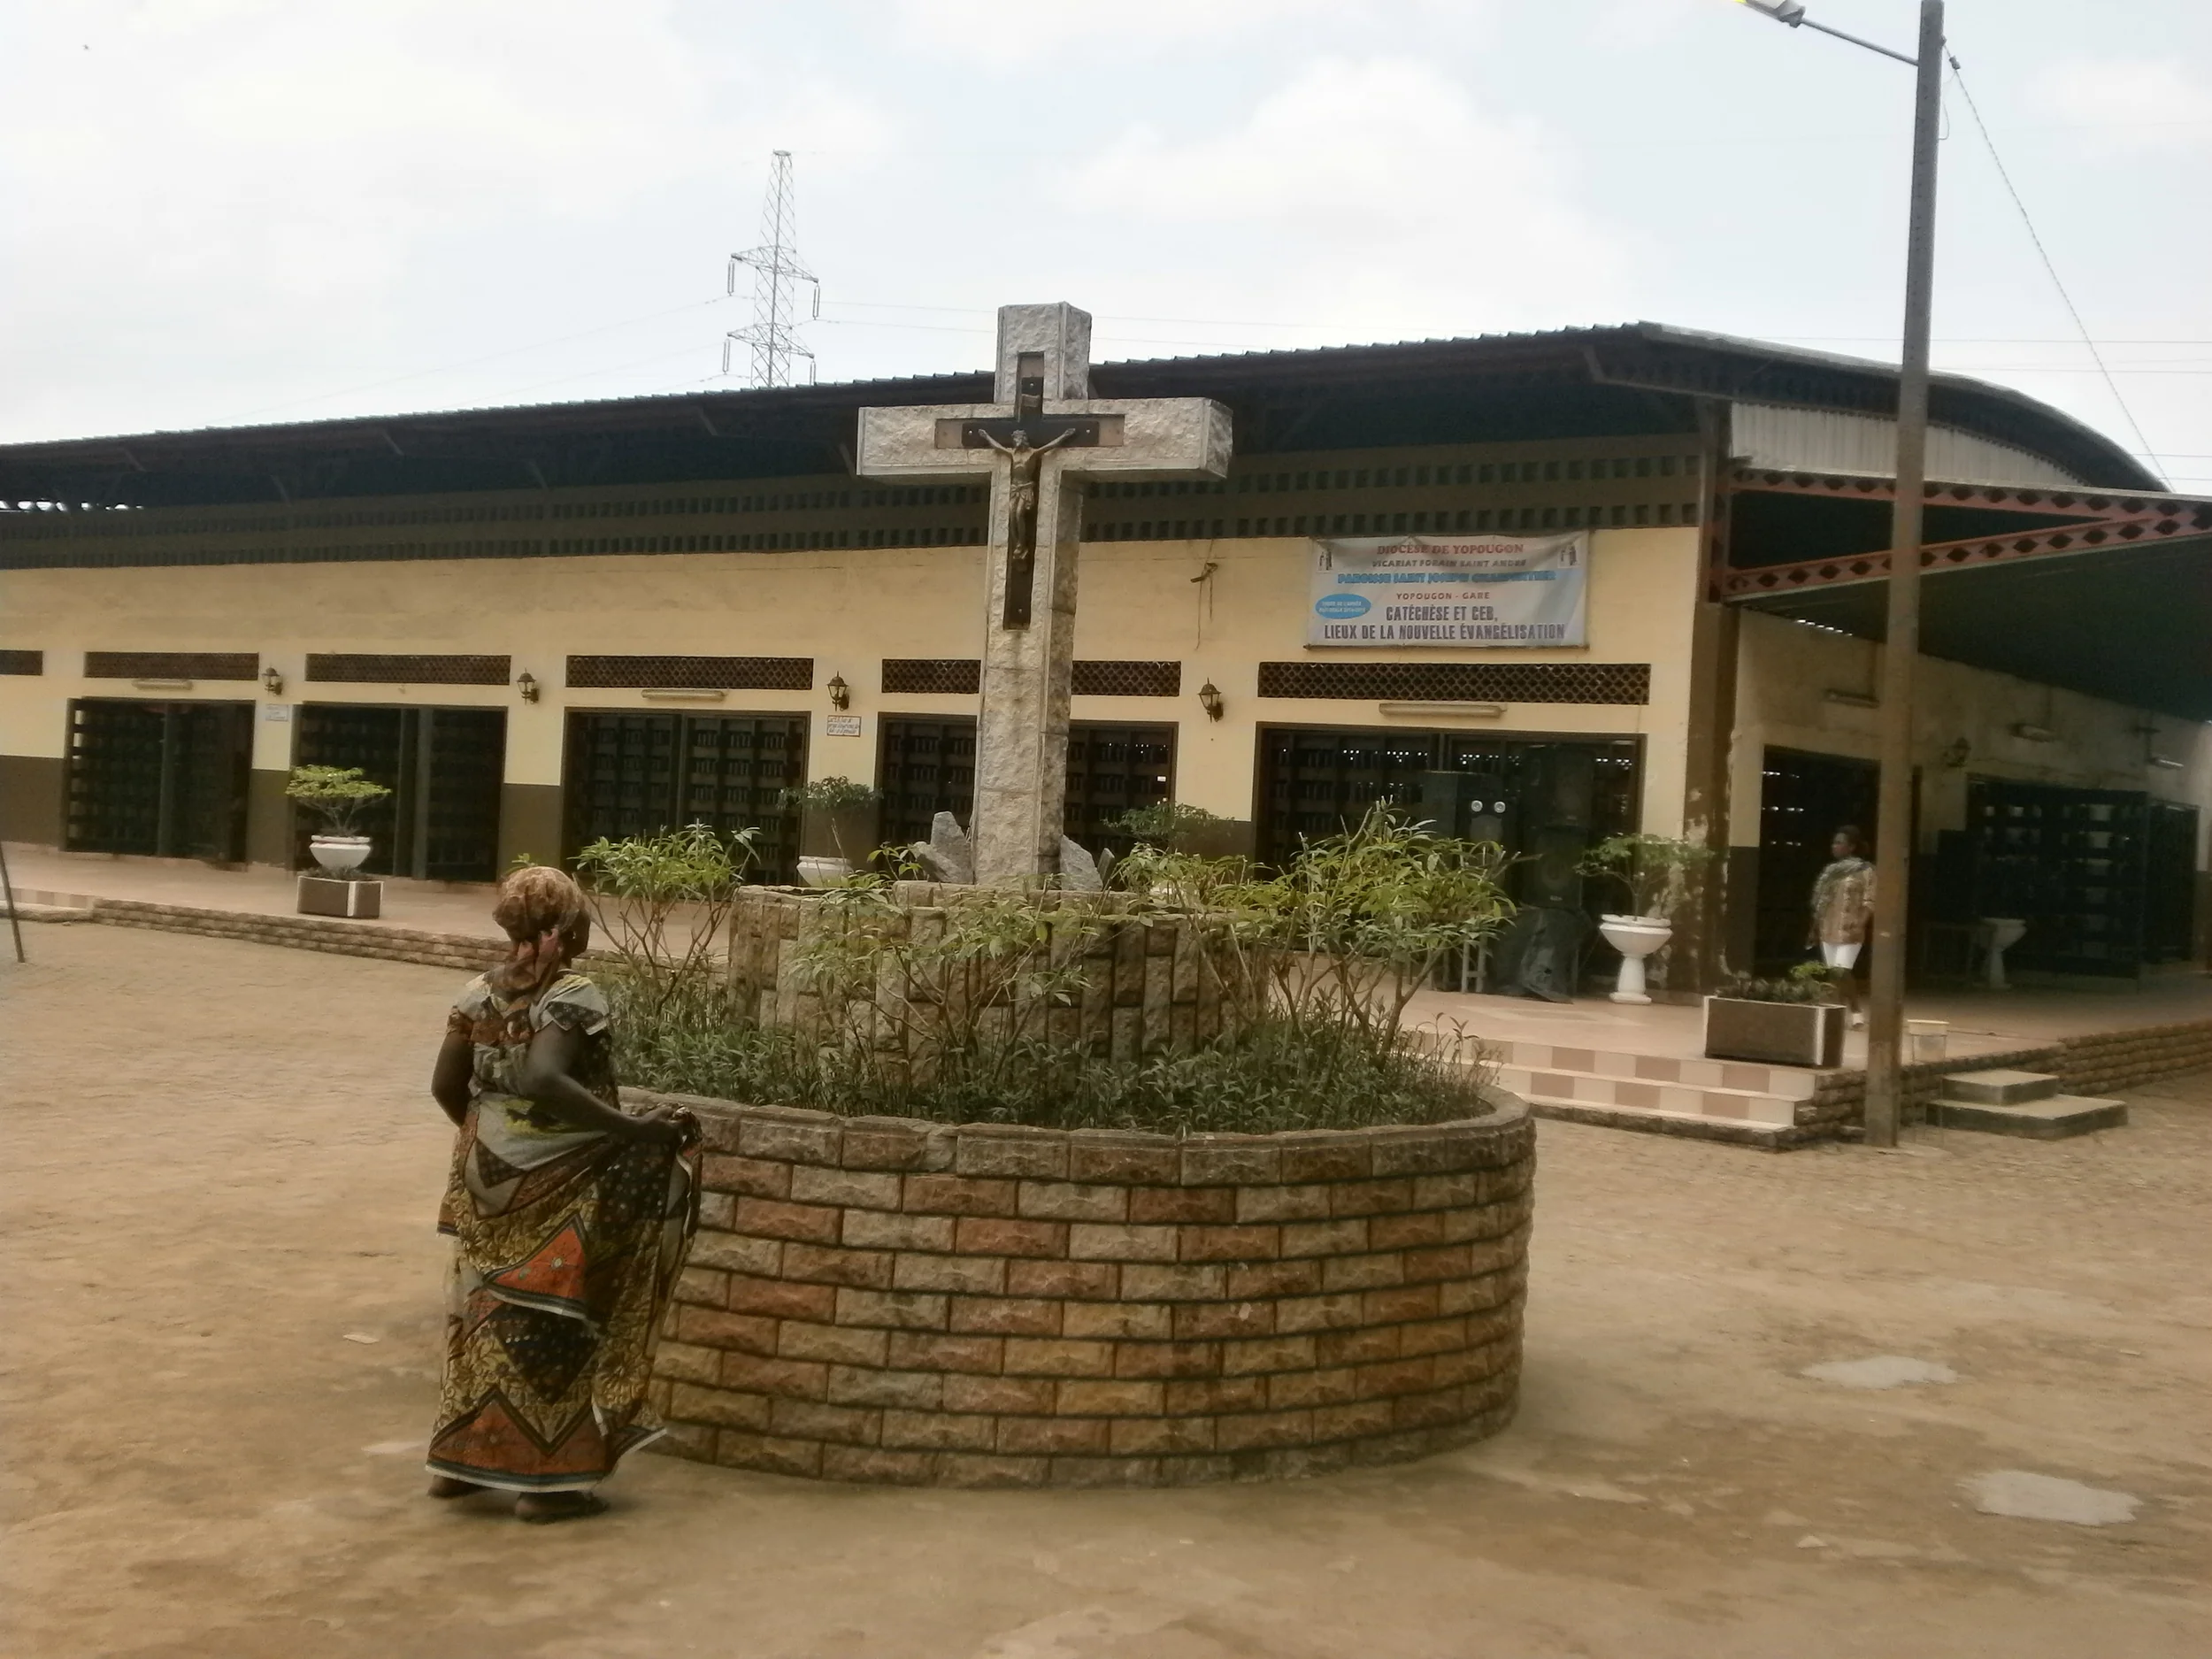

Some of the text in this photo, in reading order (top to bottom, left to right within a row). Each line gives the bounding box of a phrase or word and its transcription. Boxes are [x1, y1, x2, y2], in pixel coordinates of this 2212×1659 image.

[1431, 545, 1450, 555] DE
[1453, 544, 1524, 555] YOPOUGON
[1372, 559, 1417, 568] VICARIAT
[1460, 558, 1490, 567] SAINT
[1395, 592, 1453, 601] YOPOUGON
[1462, 591, 1491, 601] GARE
[1386, 604, 1450, 621] CATÉCHÈSE
[1453, 606, 1467, 621] ET
[1324, 622, 1565, 641] LIEUX DE LA NOUVELLE ÉVANGÉLISATION
